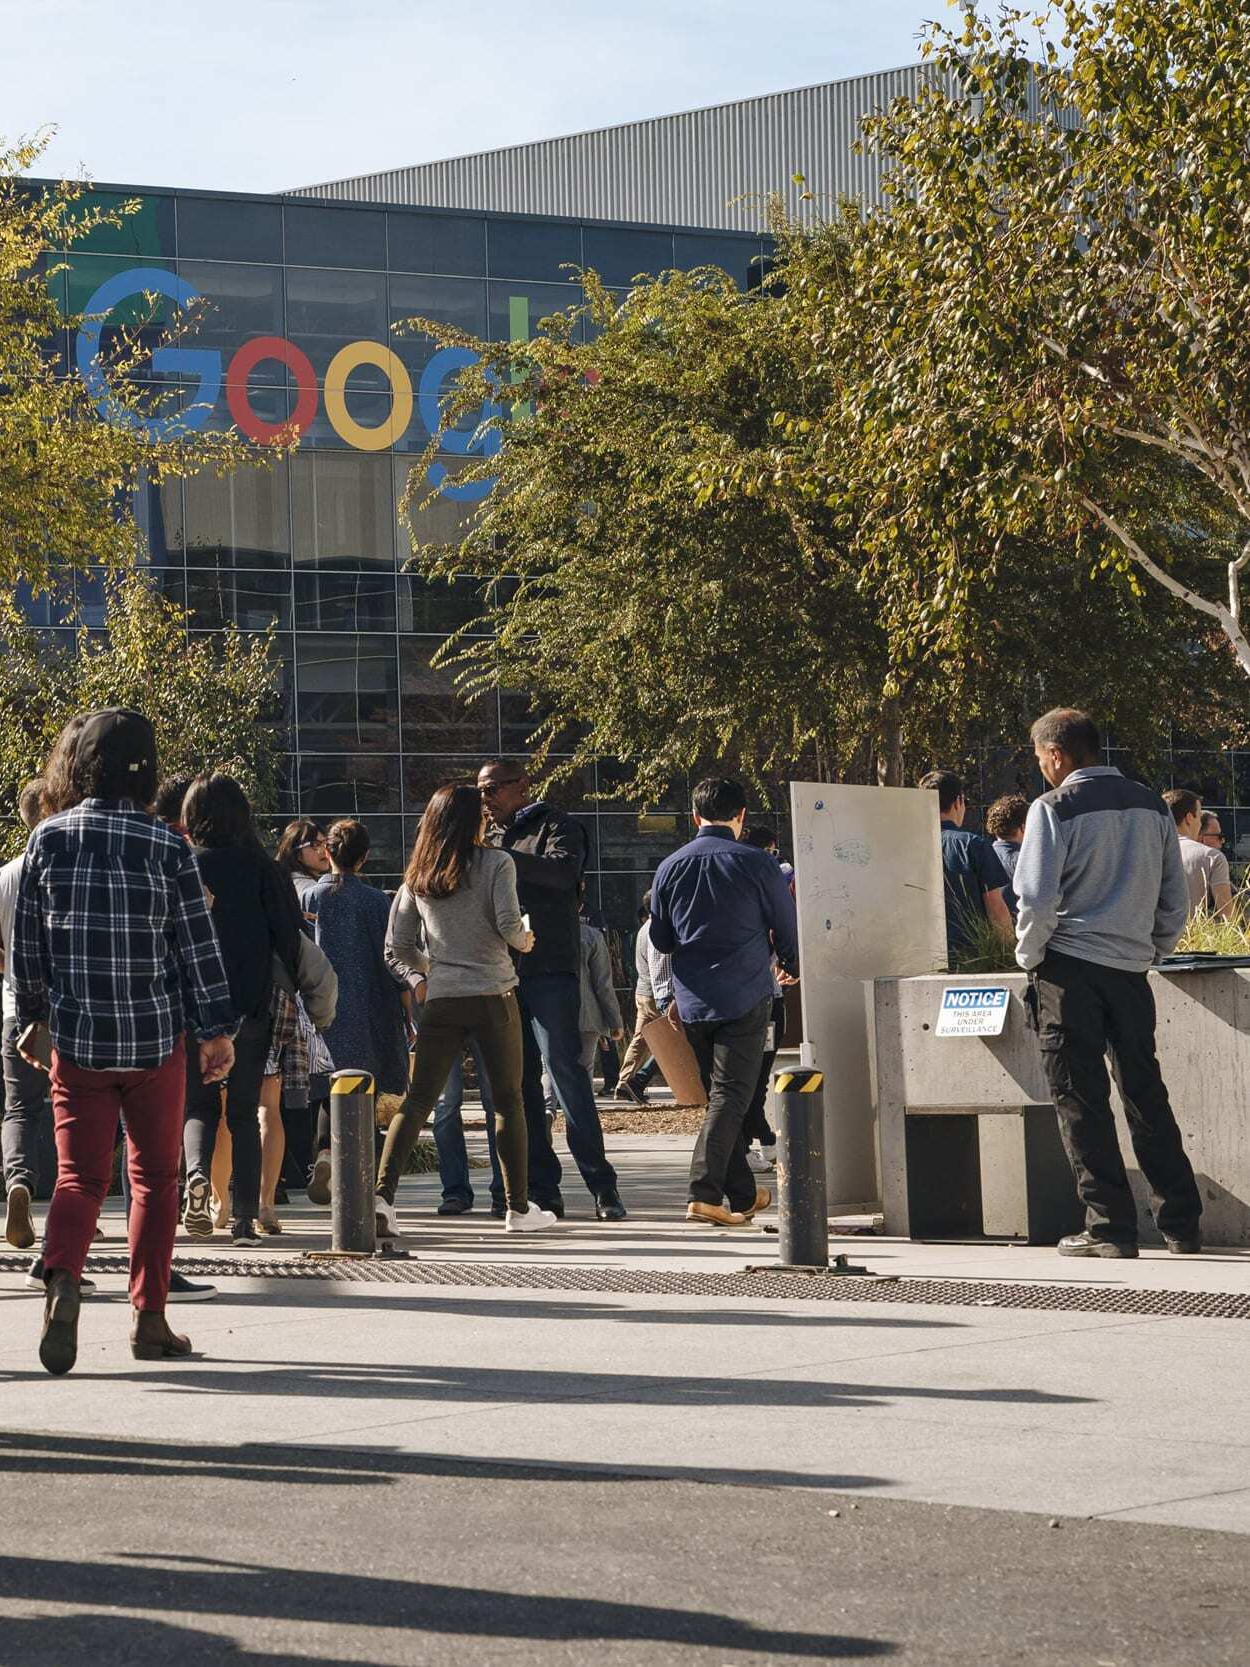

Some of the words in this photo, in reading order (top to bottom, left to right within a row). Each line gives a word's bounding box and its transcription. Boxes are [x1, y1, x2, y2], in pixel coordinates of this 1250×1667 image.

[76, 267, 601, 501] Googl
[945, 991, 1005, 1007] NOTICE
[940, 1025, 998, 1034] SURVEILLANCE
